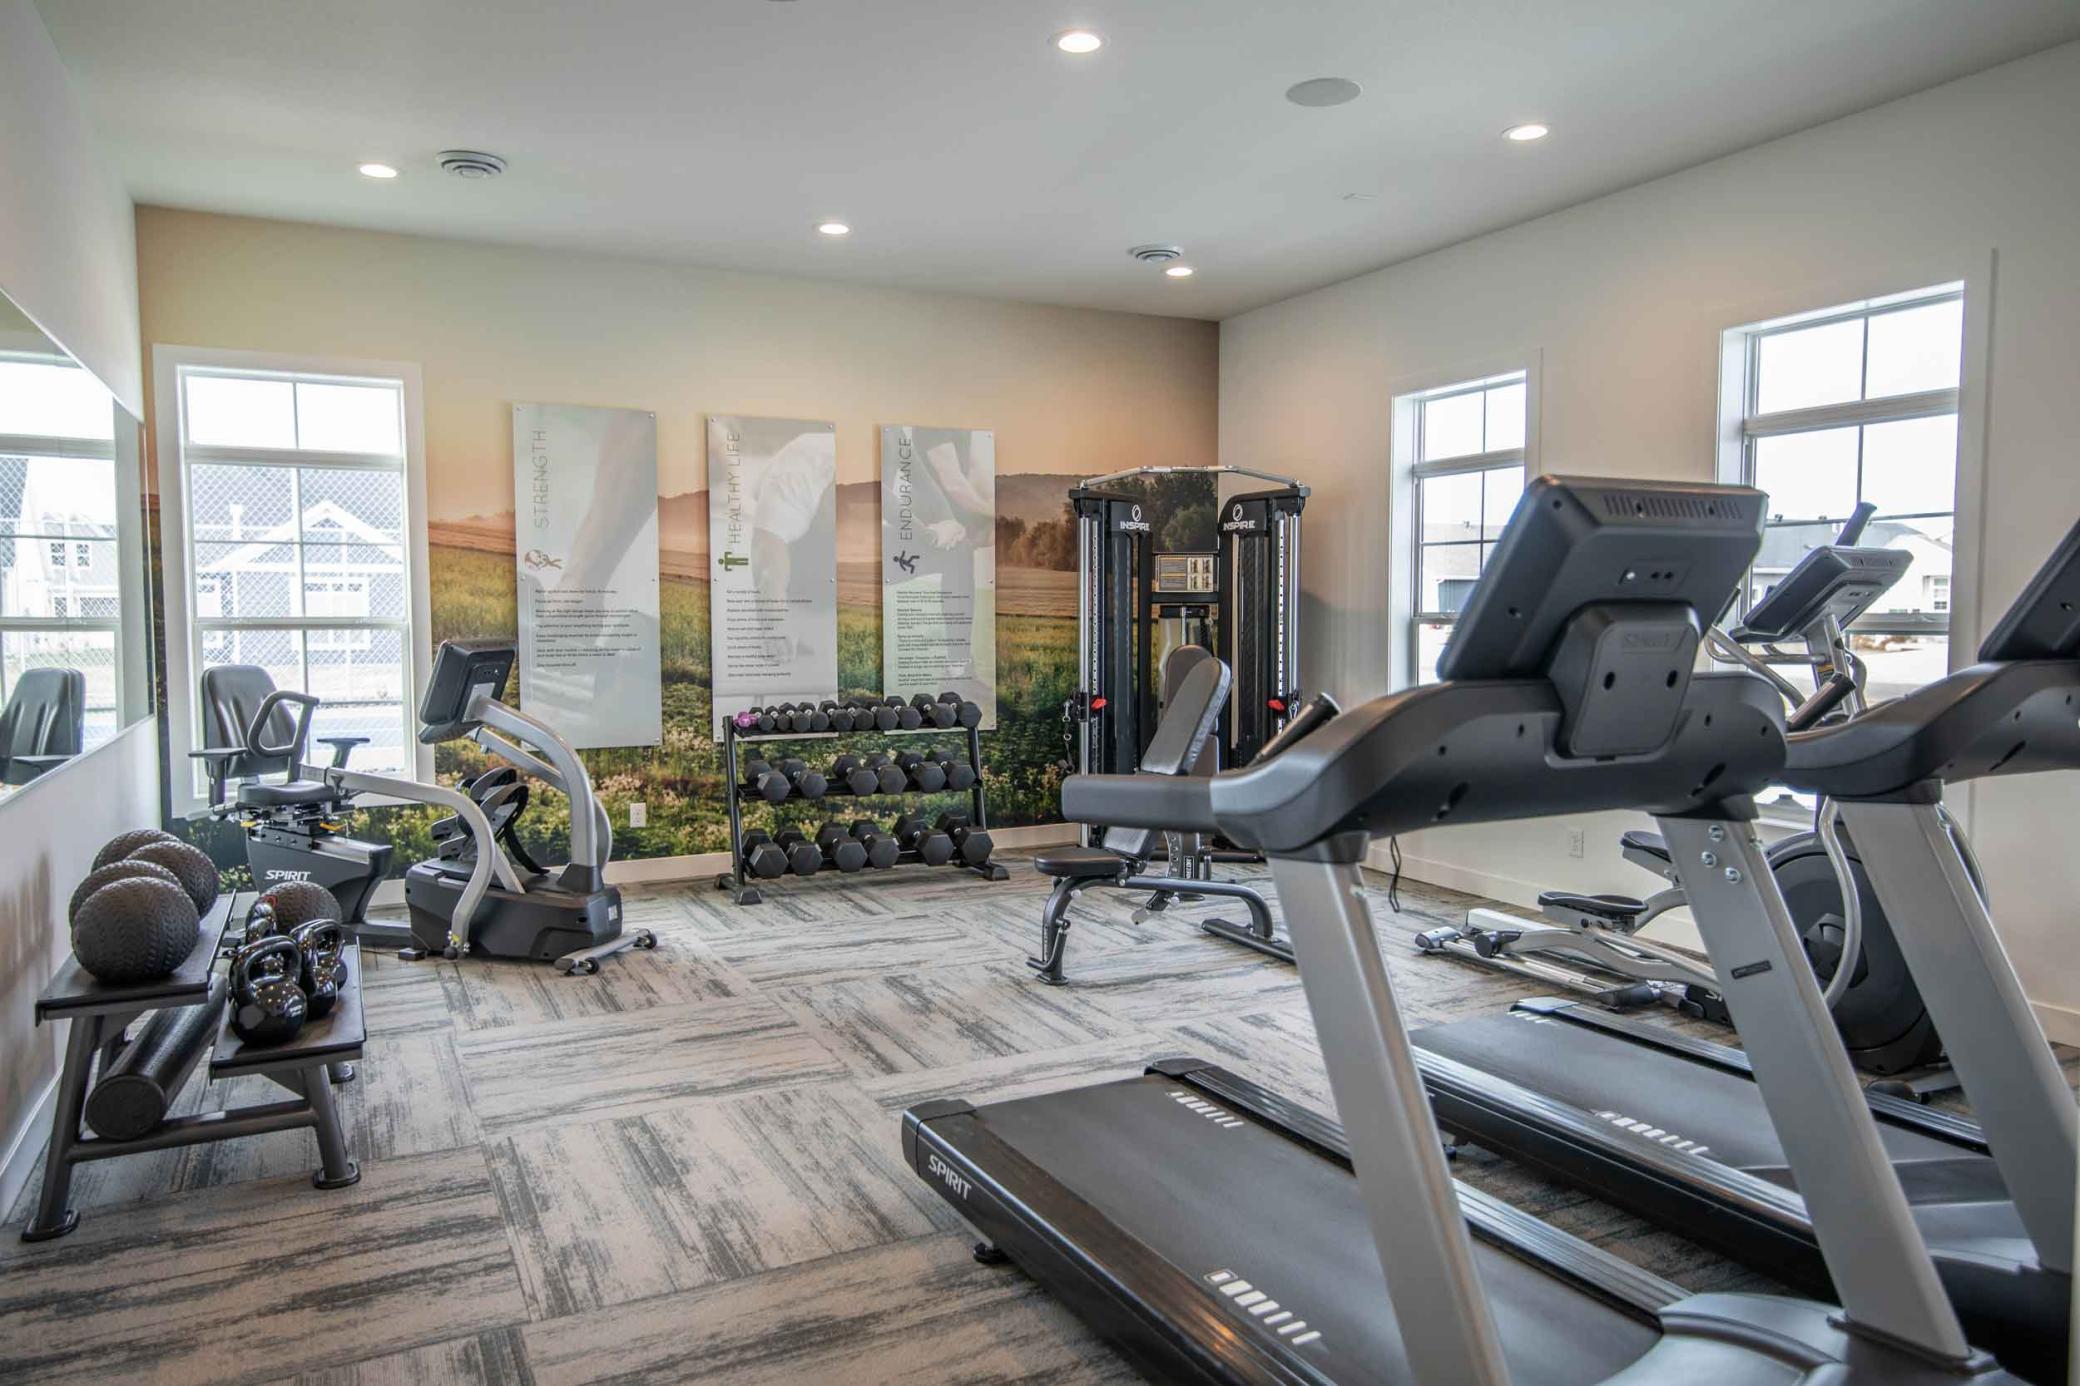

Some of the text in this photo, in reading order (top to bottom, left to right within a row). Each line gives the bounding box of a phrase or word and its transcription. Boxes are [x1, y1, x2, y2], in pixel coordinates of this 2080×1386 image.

[532, 431, 549, 528] STRENGTH
[726, 431, 741, 543] HEALTHY LIFE
[899, 438, 913, 540] ENDURANCE
[264, 869, 312, 881] SPIRIT
[928, 1154, 972, 1200] SPIRIT
